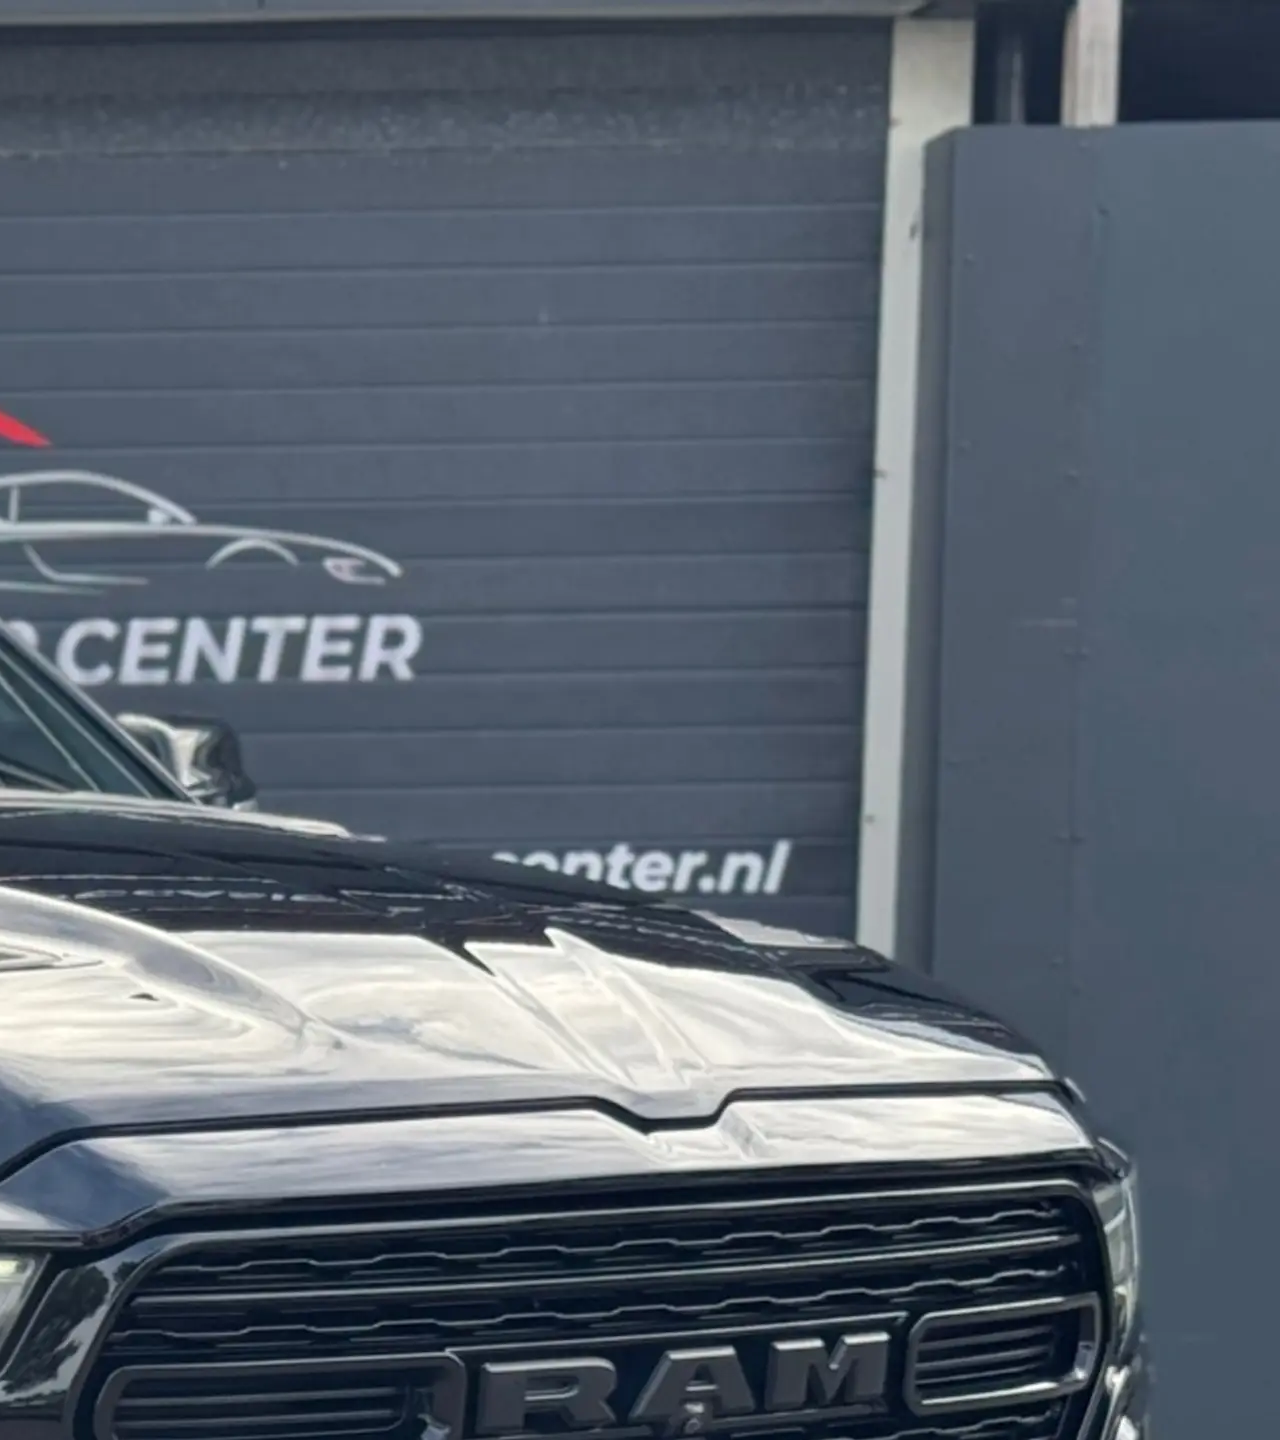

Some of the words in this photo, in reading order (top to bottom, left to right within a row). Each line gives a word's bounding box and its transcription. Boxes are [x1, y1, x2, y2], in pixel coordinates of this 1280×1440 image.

[55, 613, 423, 686] CENTER
[491, 839, 792, 894] nter.nl
[474, 1330, 891, 1436] RAM
